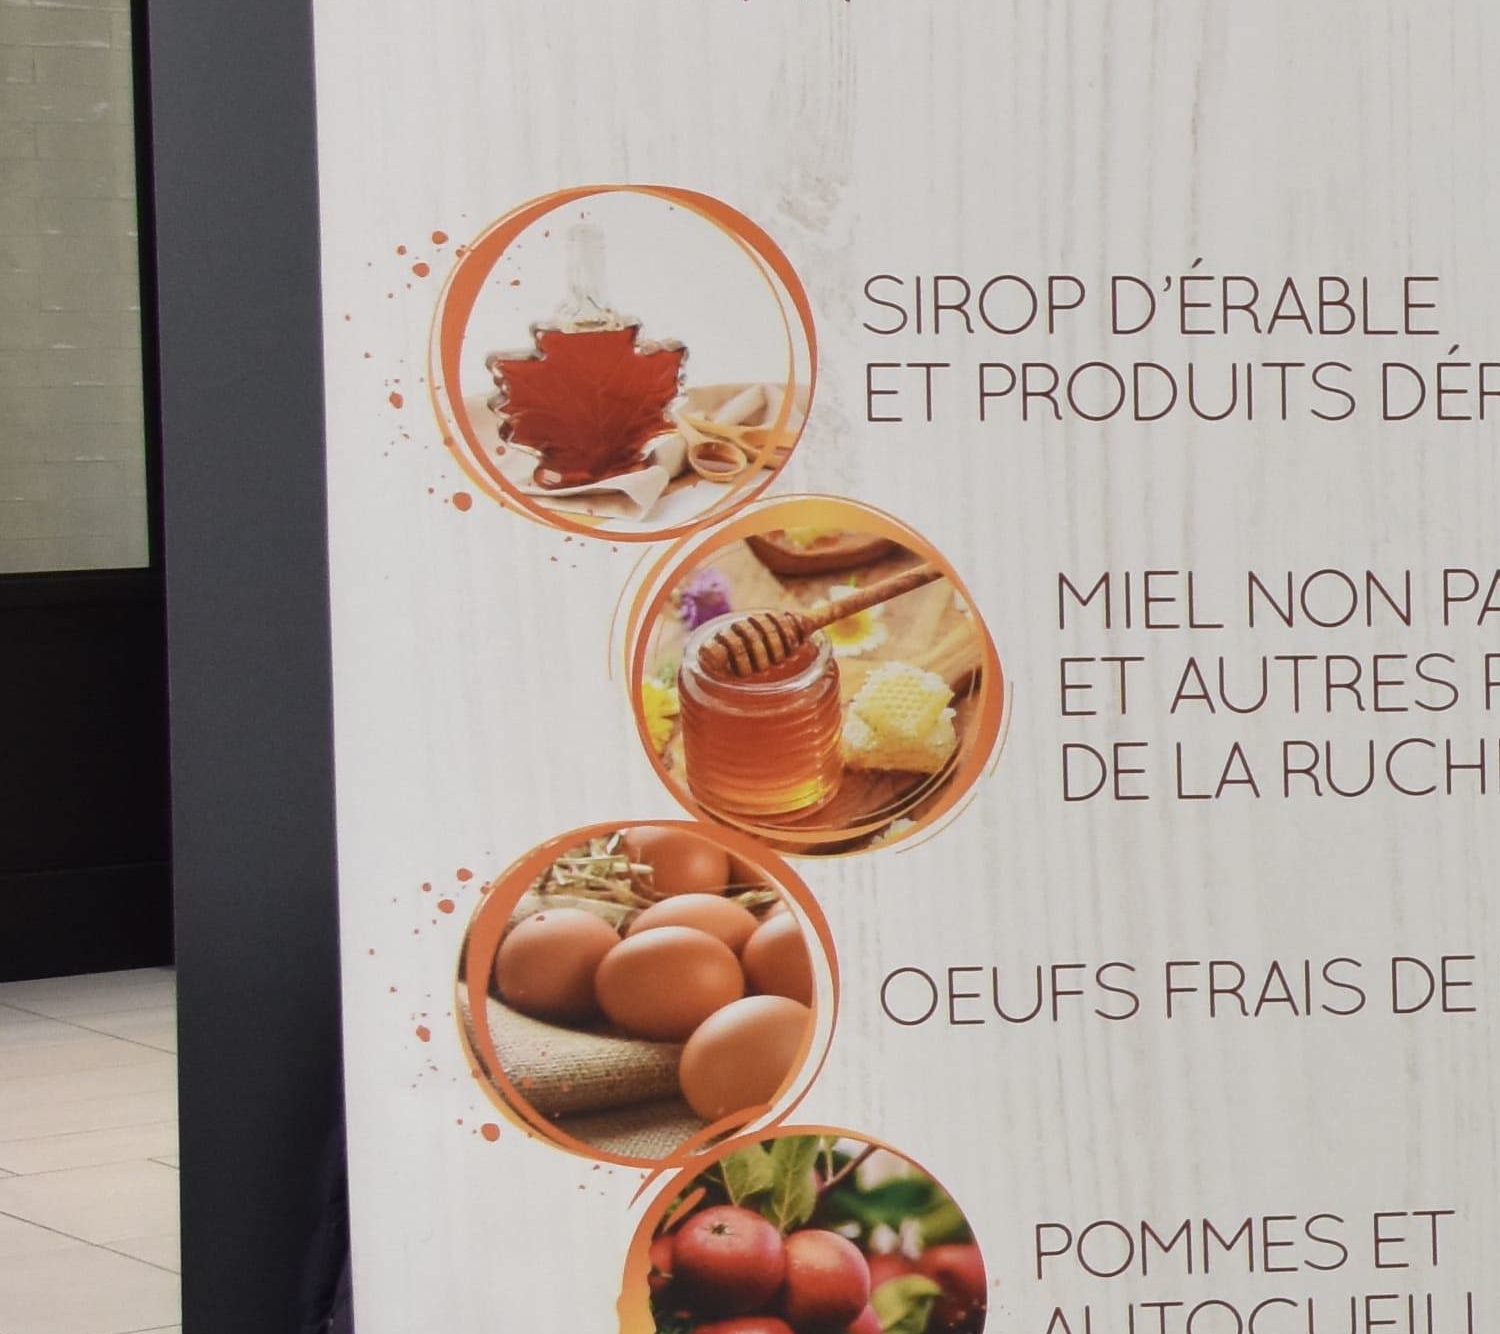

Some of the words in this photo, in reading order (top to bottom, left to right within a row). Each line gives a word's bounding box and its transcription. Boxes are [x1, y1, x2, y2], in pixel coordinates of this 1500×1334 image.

[863, 275, 1085, 334] SIROP
[867, 363, 950, 422] ET
[979, 362, 1355, 421] PRODUITS
[1059, 571, 1224, 629] MIEL
[1248, 569, 1411, 627] NON
[1061, 657, 1144, 716] ET
[1171, 653, 1458, 713] AUTRES
[1063, 742, 1149, 801] DE
[1177, 742, 1260, 799] LA
[881, 962, 1139, 1025] OEUFS
[1166, 958, 1365, 1019] FRAIS
[1392, 956, 1476, 1013] DE
[1036, 1214, 1348, 1279] POMMES
[1374, 1210, 1455, 1268] ET
